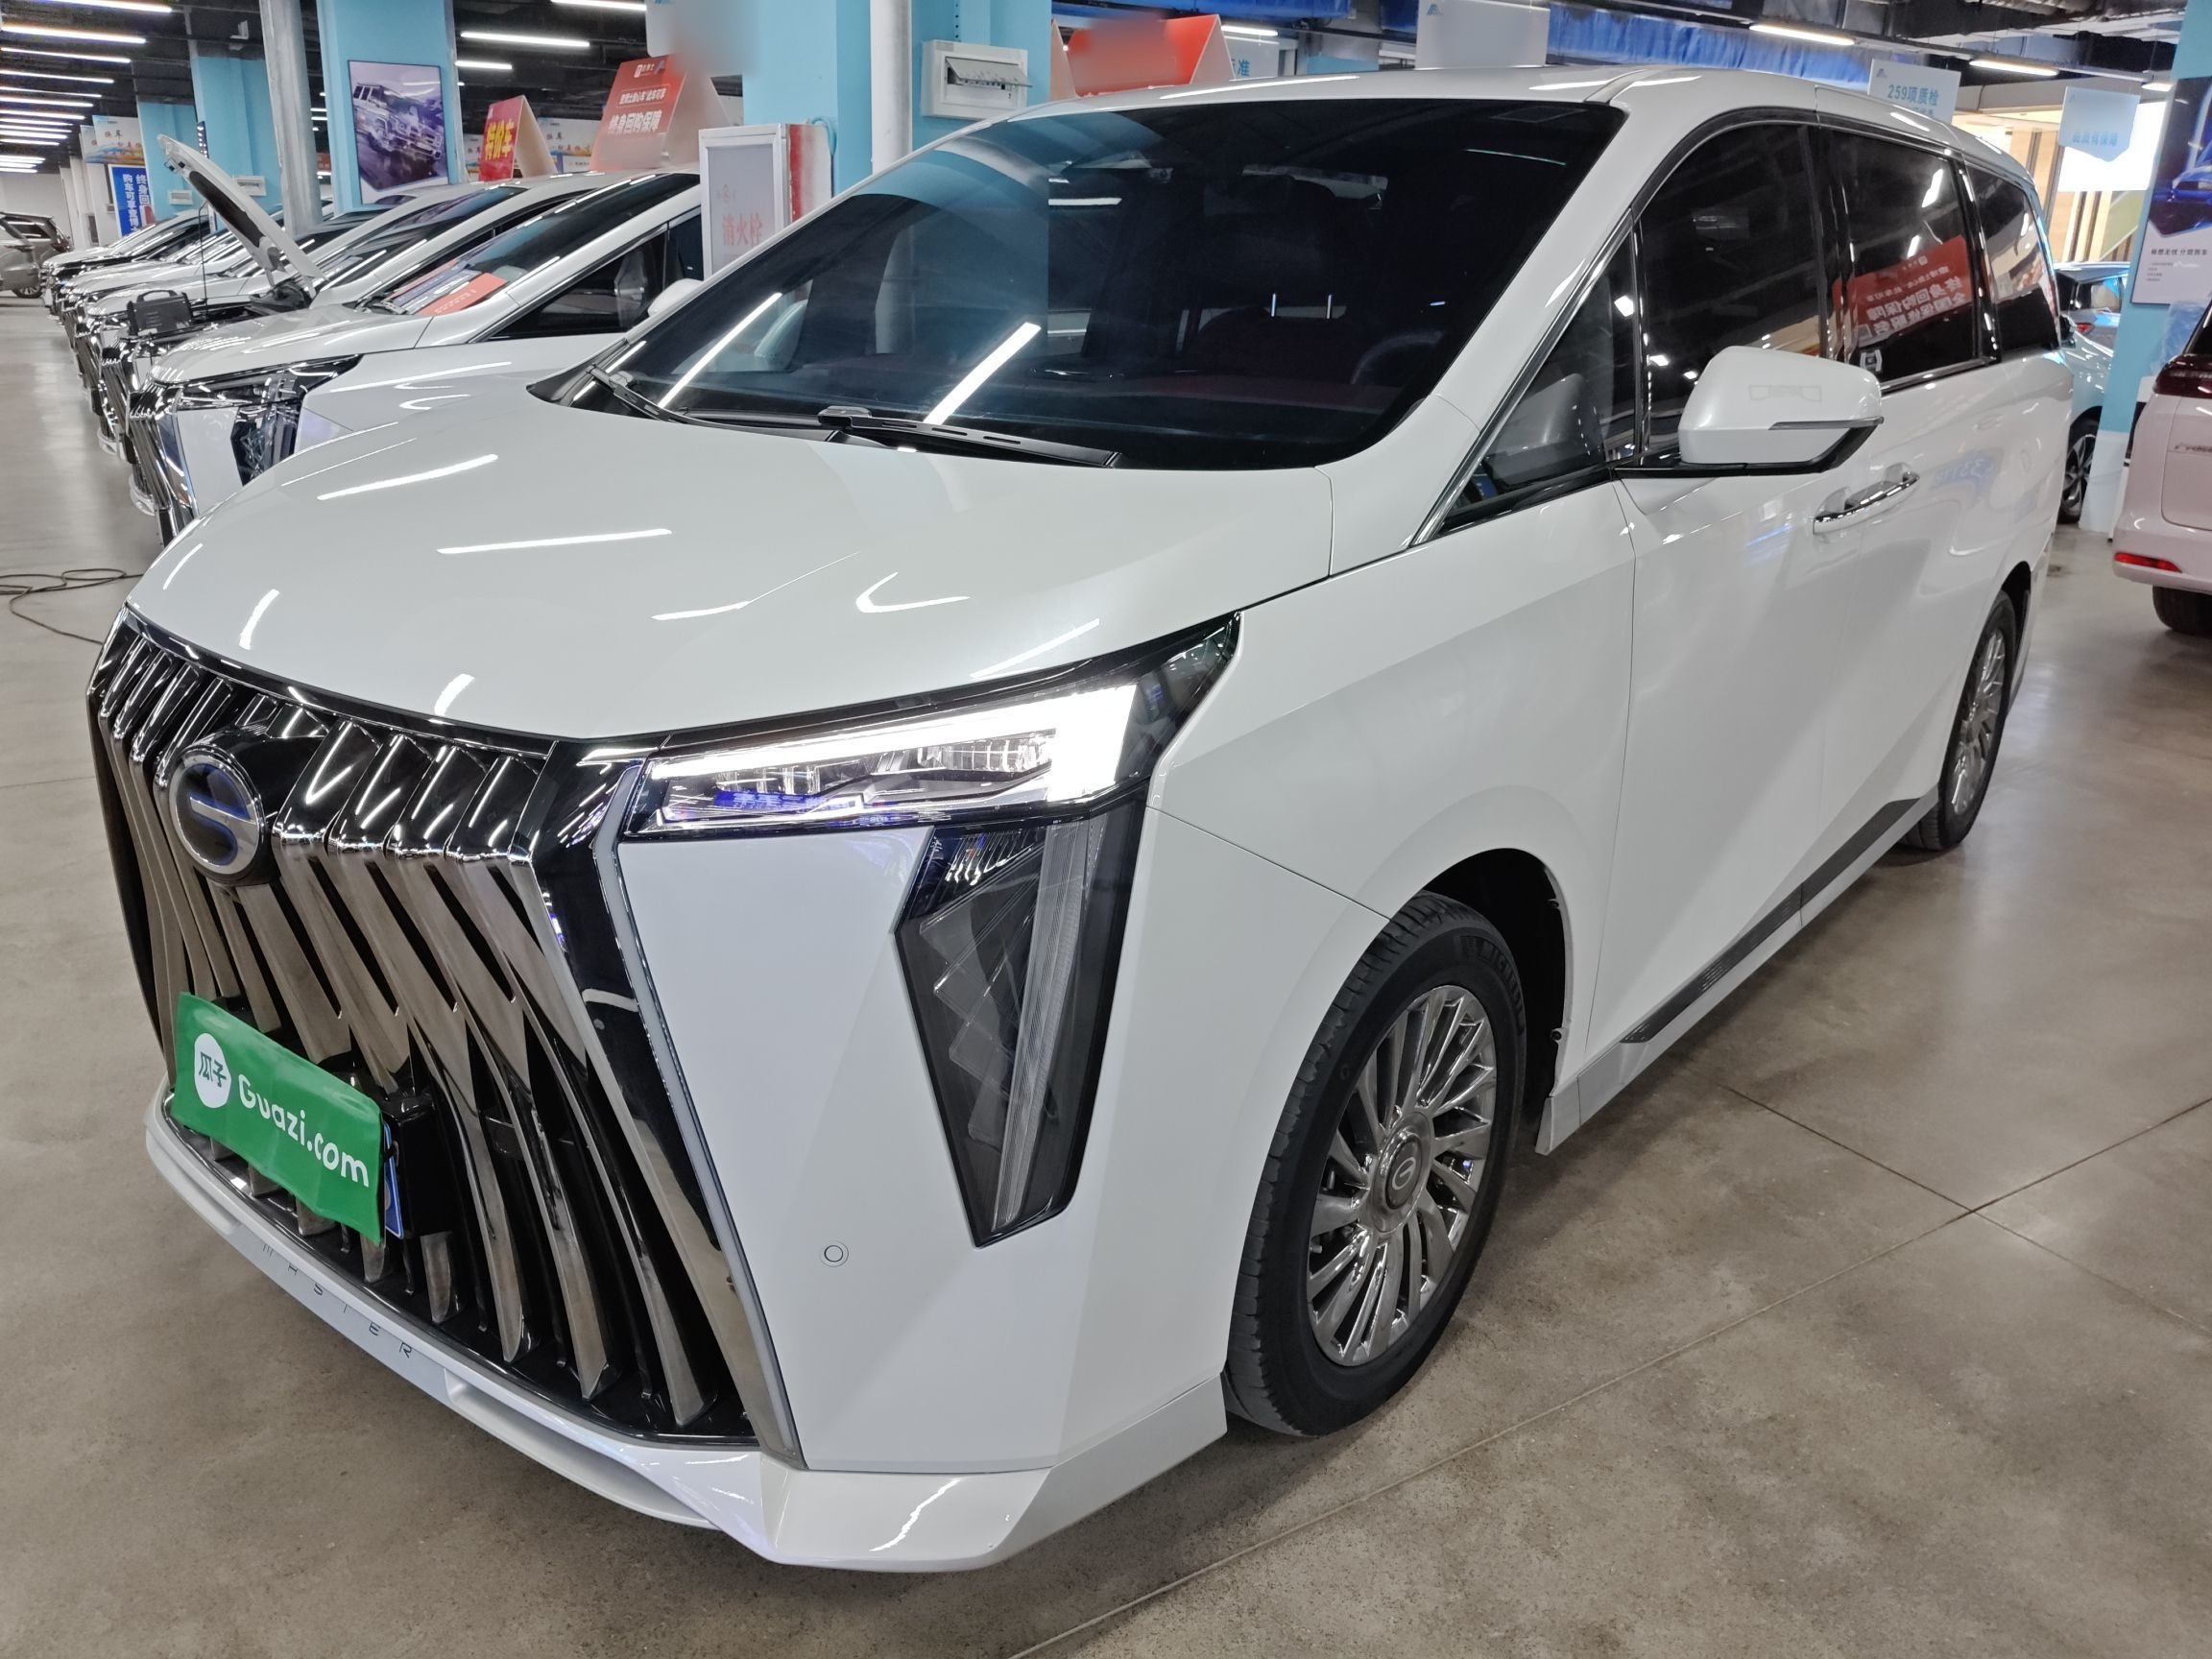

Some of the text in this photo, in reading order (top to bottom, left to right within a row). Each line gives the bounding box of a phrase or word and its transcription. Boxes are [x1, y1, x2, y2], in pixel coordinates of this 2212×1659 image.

[485, 118, 515, 161] 特价车
[199, 1051, 228, 1088] 瓜子
[238, 1073, 370, 1188] Guazi.com
